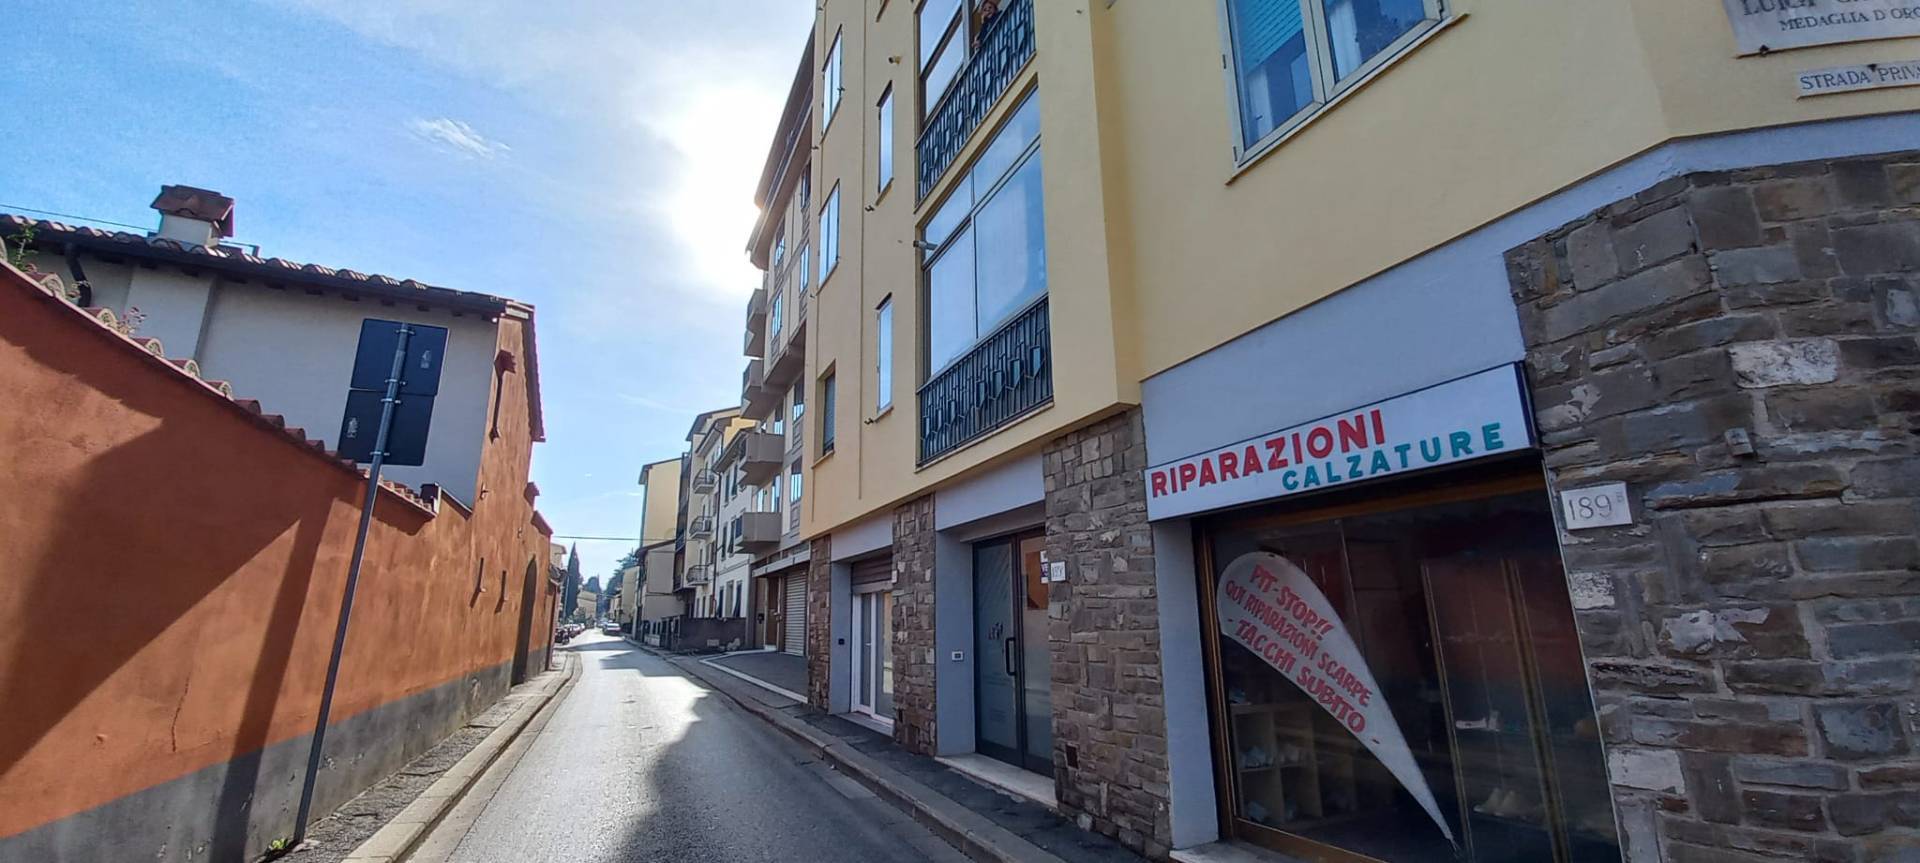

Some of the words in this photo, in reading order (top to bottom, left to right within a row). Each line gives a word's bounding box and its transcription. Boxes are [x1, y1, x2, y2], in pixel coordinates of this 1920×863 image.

[1779, 11, 1871, 31] MEDAGLIA
[1800, 70, 1872, 90] STRADA
[1151, 409, 1386, 498] RIPARAZIONI
[1282, 422, 1505, 491] CALZATURE
[1568, 494, 1613, 521] 189
[1225, 579, 1247, 605] QUI
[1243, 593, 1319, 661] RIPARAZIONI
[1317, 651, 1373, 707] SCARPE
[1235, 619, 1297, 674] TACCHI
[1296, 666, 1367, 734] SUBITO
